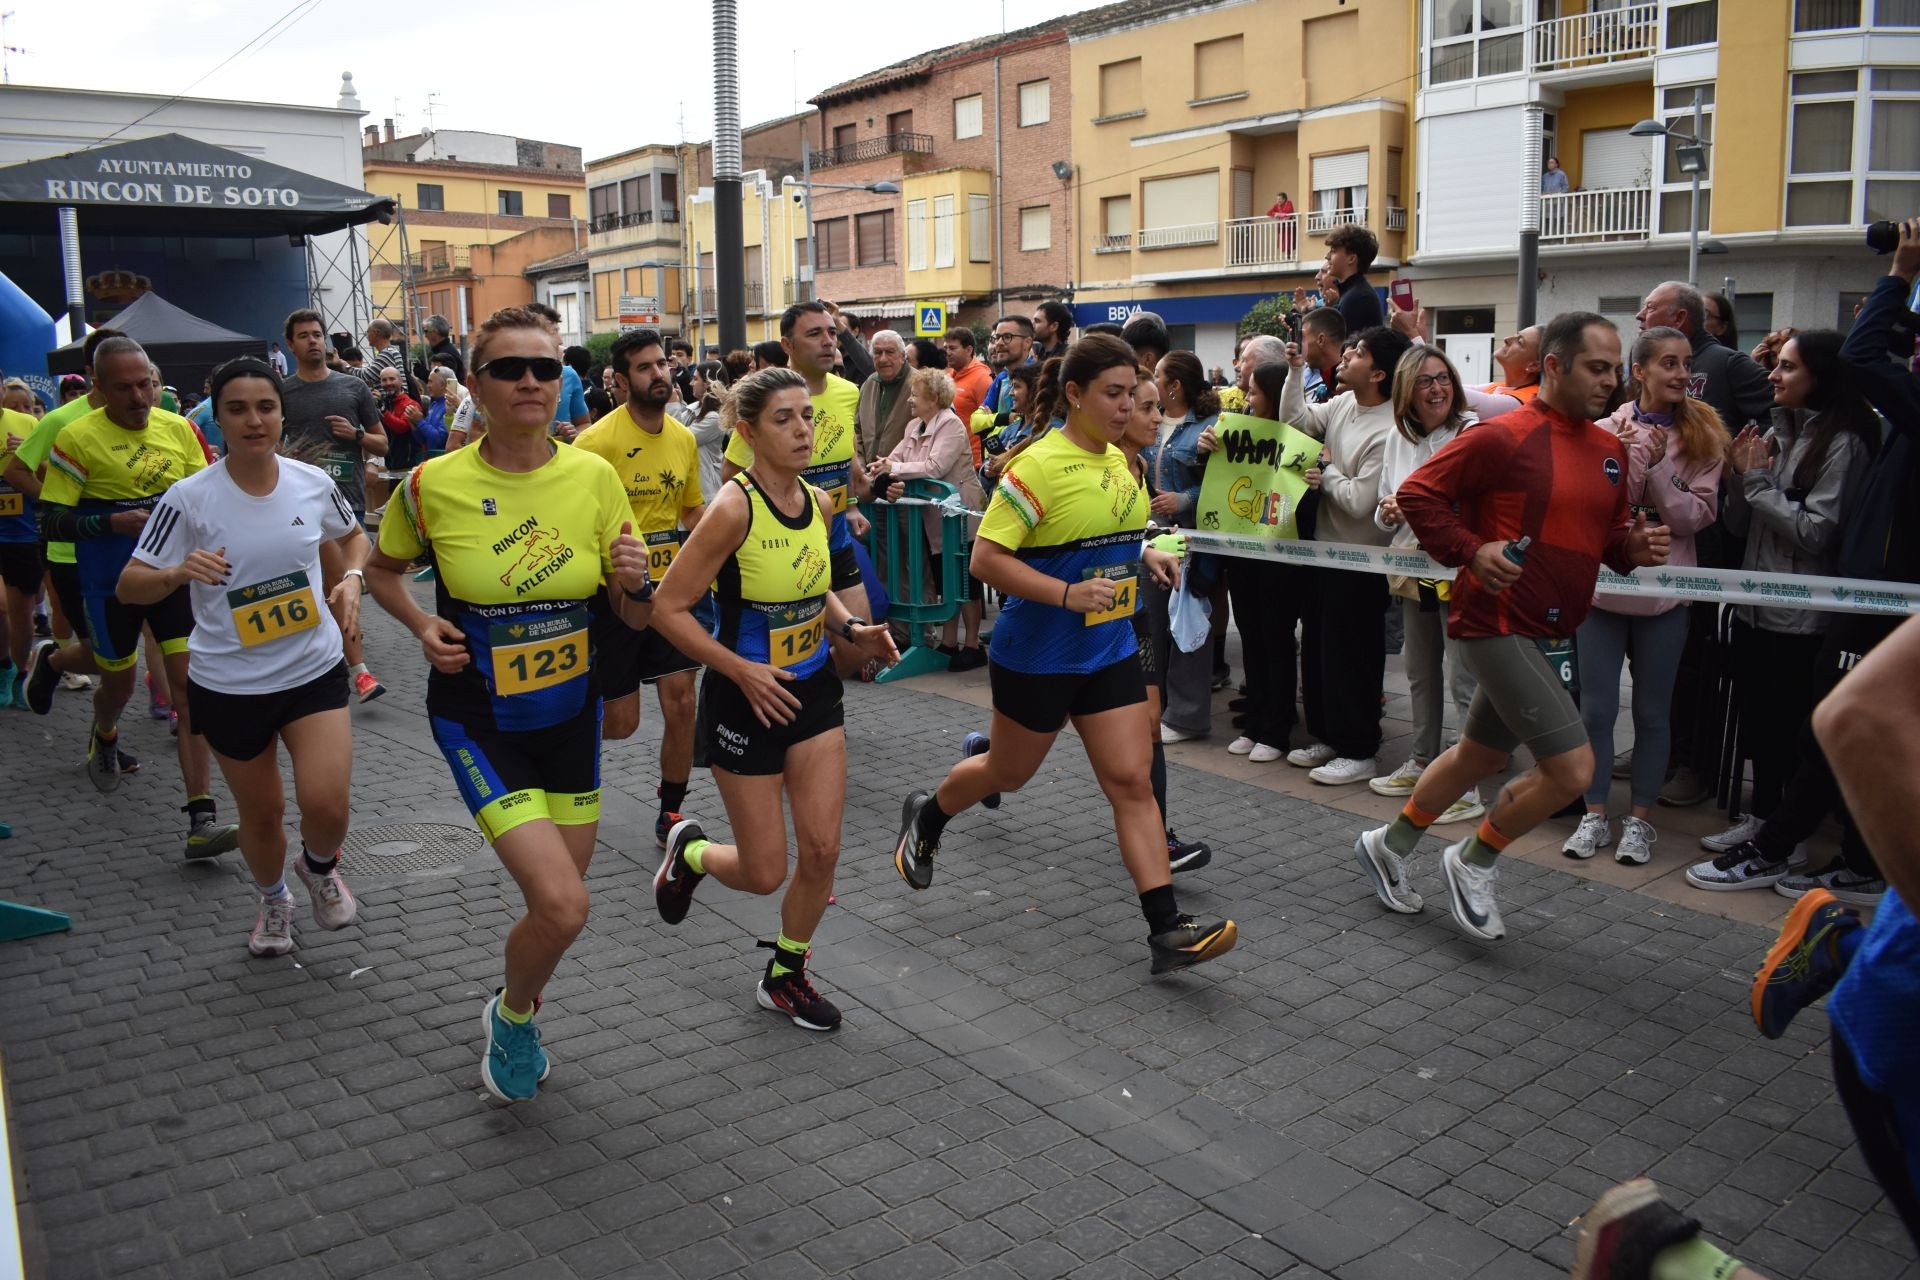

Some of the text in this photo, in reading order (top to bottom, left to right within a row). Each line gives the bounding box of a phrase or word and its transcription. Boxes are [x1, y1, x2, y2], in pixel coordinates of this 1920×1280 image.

[98, 159, 252, 179] AYUNTAMIENTO
[47, 179, 299, 207] RINCON DE SOTO
[820, 426, 845, 460] ATLETISMO
[126, 443, 147, 469] RINCON
[142, 459, 172, 492] ATLETISMO
[633, 473, 650, 483] Las
[492, 516, 538, 556] RINCON
[792, 544, 809, 570] RINCON
[516, 547, 574, 597] ATLETISMO
[803, 560, 827, 596] ATLETISMO
[1675, 576, 1720, 585] CAJA RURAL
[1688, 583, 1723, 592] NAVARRA
[1760, 582, 1808, 592] CAJA RURAL
[1774, 589, 1812, 599] NAVARRA
[1854, 589, 1906, 600] CAJA RURAL
[508, 606, 523, 614] DE
[1854, 596, 1908, 608] DE NAVARRA
[247, 599, 308, 633] 116
[528, 617, 570, 631] CAJA RURAL
[529, 622, 573, 637] DE NAVARRA
[781, 621, 822, 657] 120
[509, 643, 578, 682] 123
[1560, 660, 1572, 682] 6
[500, 791, 530, 806] RINCÓN
[502, 797, 532, 810] DE SOTO
